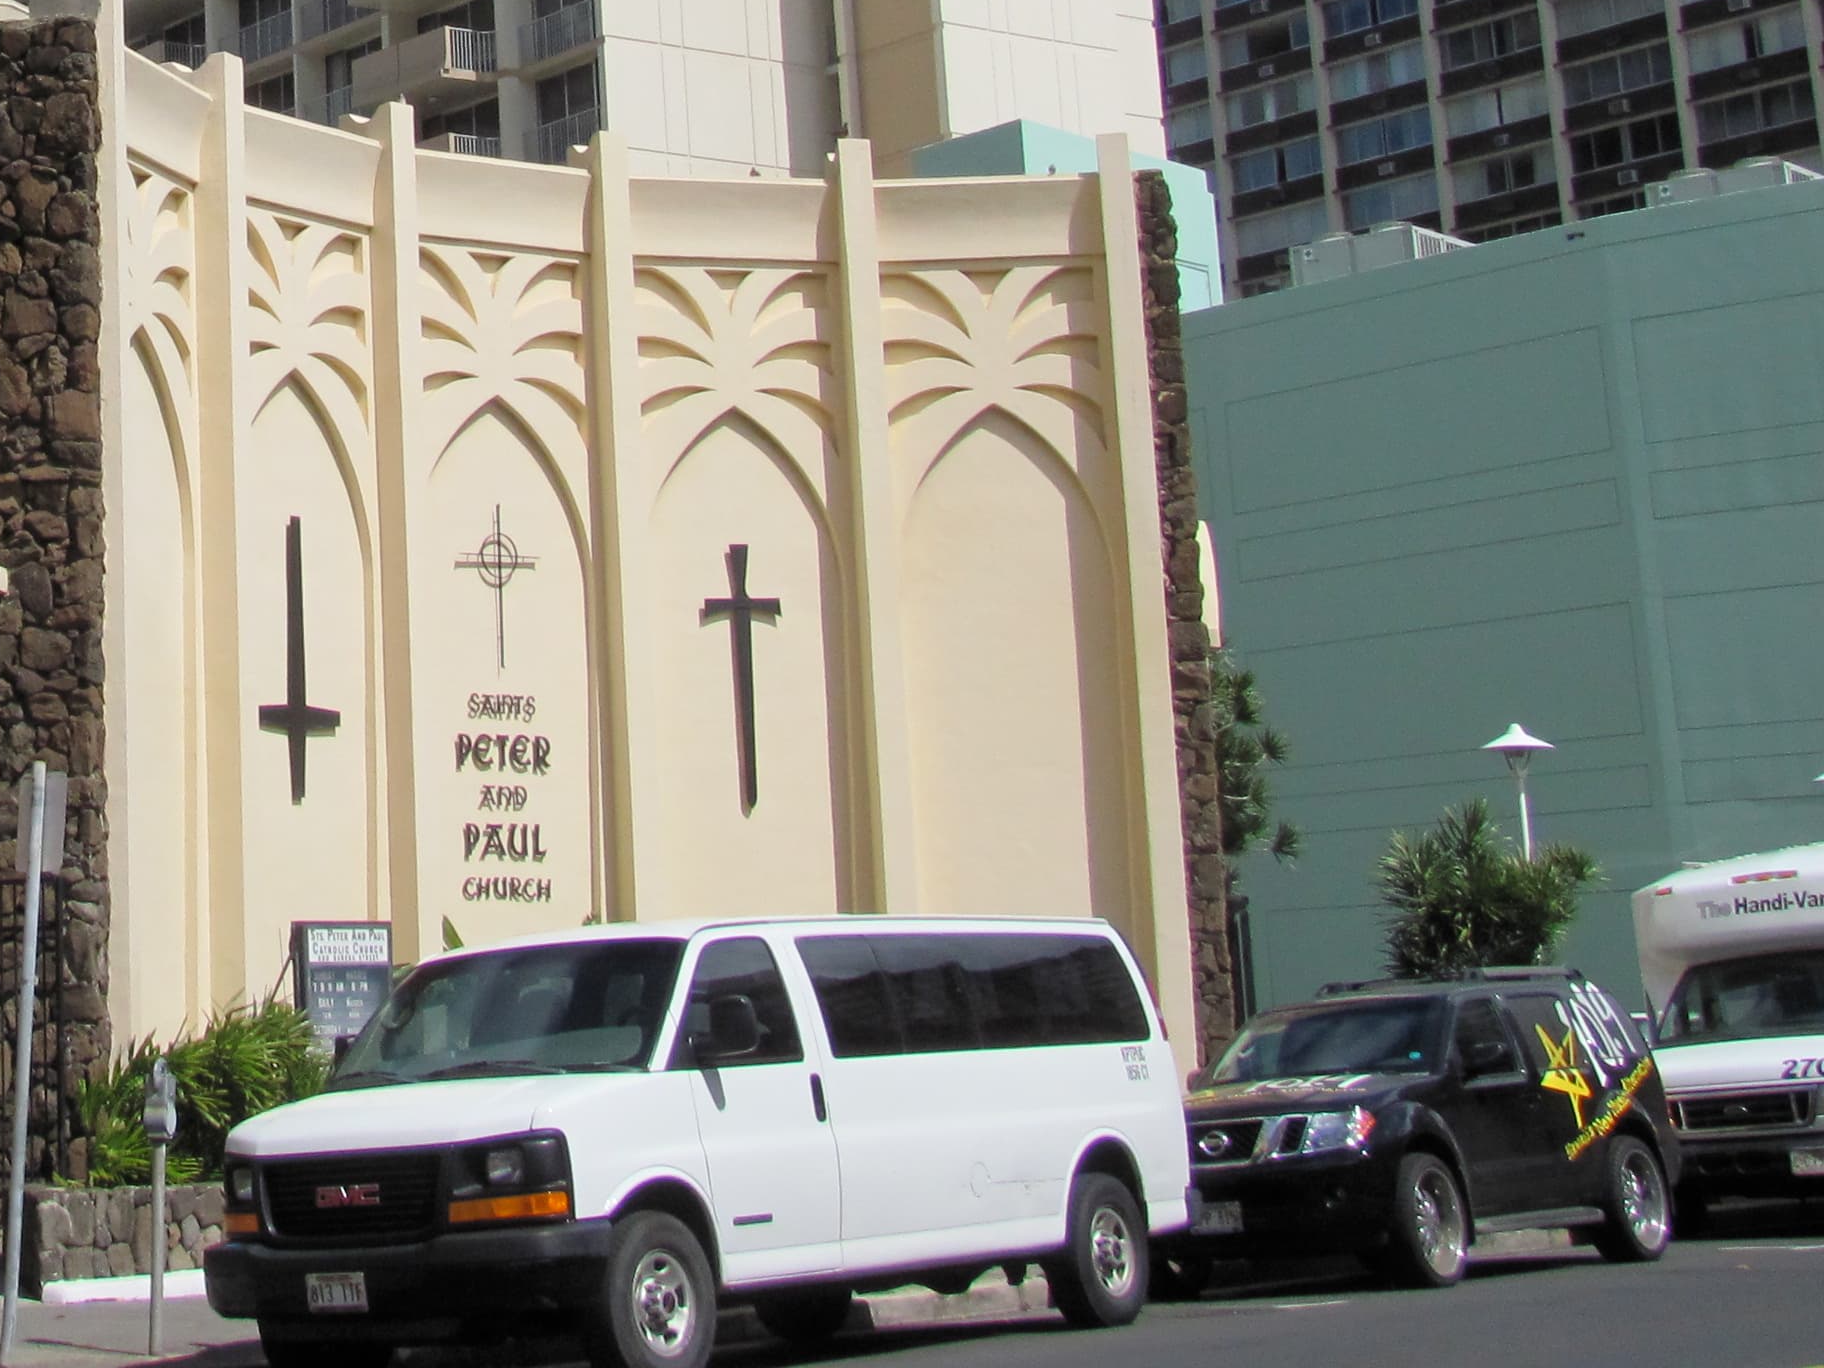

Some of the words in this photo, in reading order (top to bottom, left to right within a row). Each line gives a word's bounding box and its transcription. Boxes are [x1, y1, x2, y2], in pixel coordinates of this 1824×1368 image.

[467, 692, 537, 717] SAINTS
[455, 733, 552, 770] PETER
[478, 784, 528, 810] AND
[463, 822, 548, 860] PAUL
[462, 876, 552, 900] CHURCH
[1696, 901, 1731, 920] The
[352, 942, 384, 954] CHURCH
[316, 1184, 380, 1208] GMC
